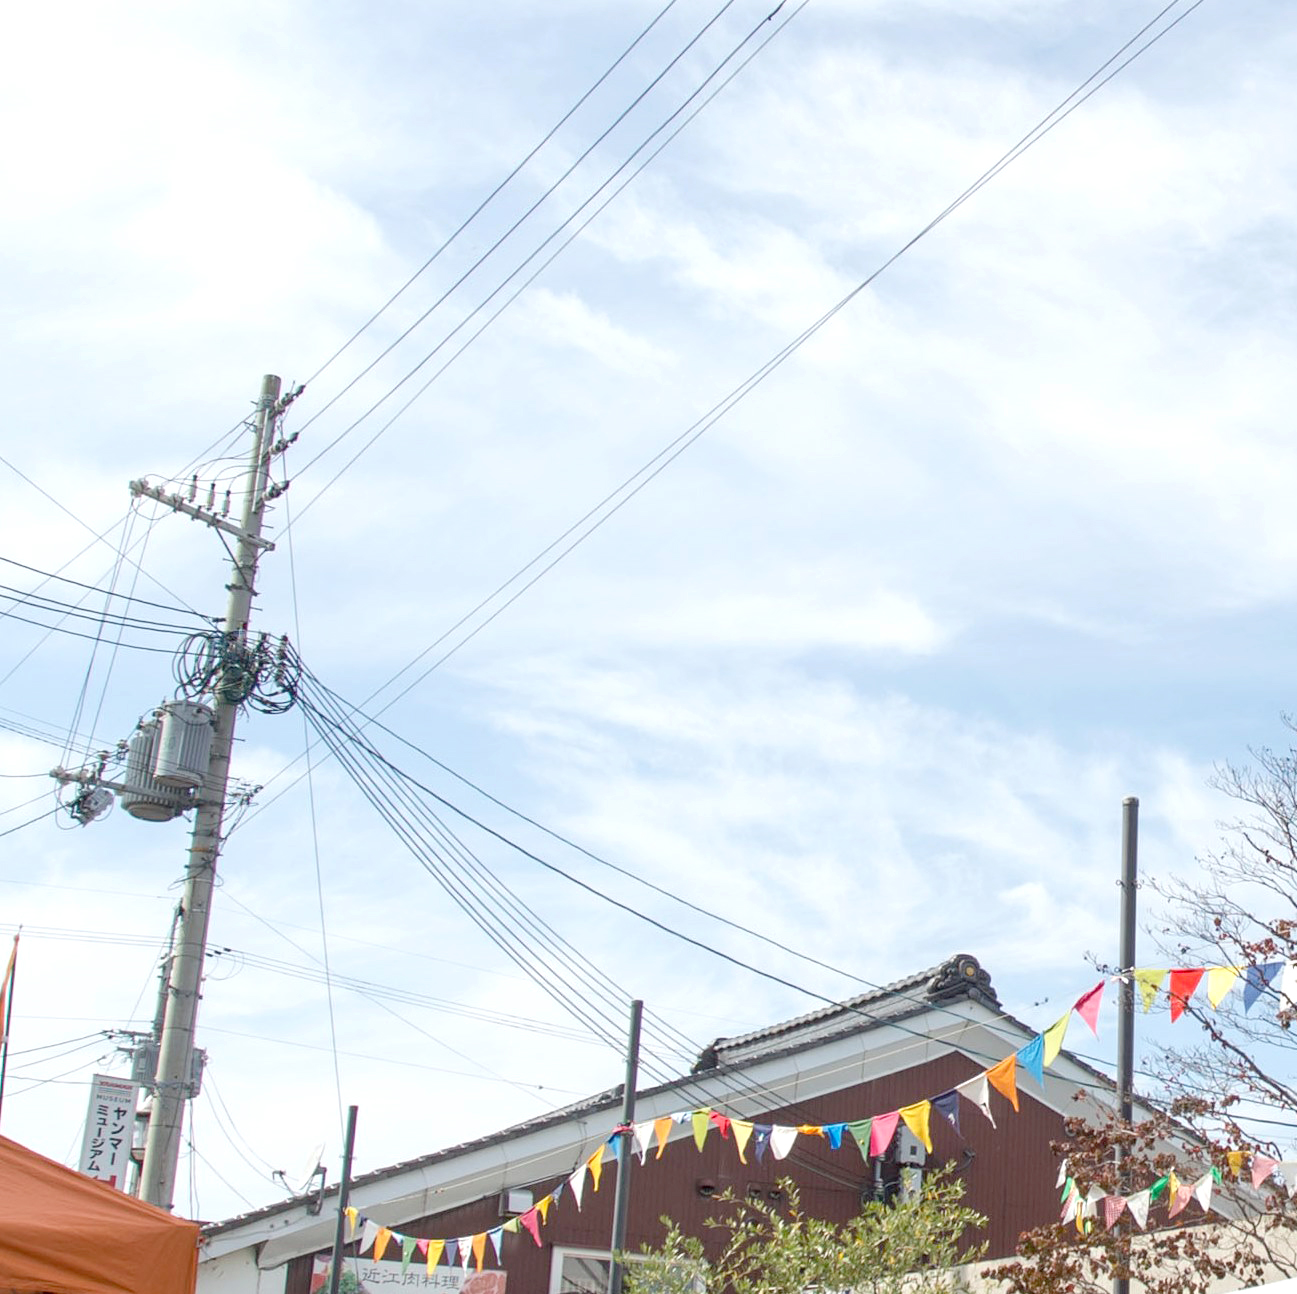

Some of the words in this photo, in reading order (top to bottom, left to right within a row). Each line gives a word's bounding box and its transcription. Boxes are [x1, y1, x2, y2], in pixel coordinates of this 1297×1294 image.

[87, 1104, 110, 1172] ミュージアム
[109, 1106, 128, 1166] ヤンマー
[361, 1266, 461, 1291] 近江肉料理
